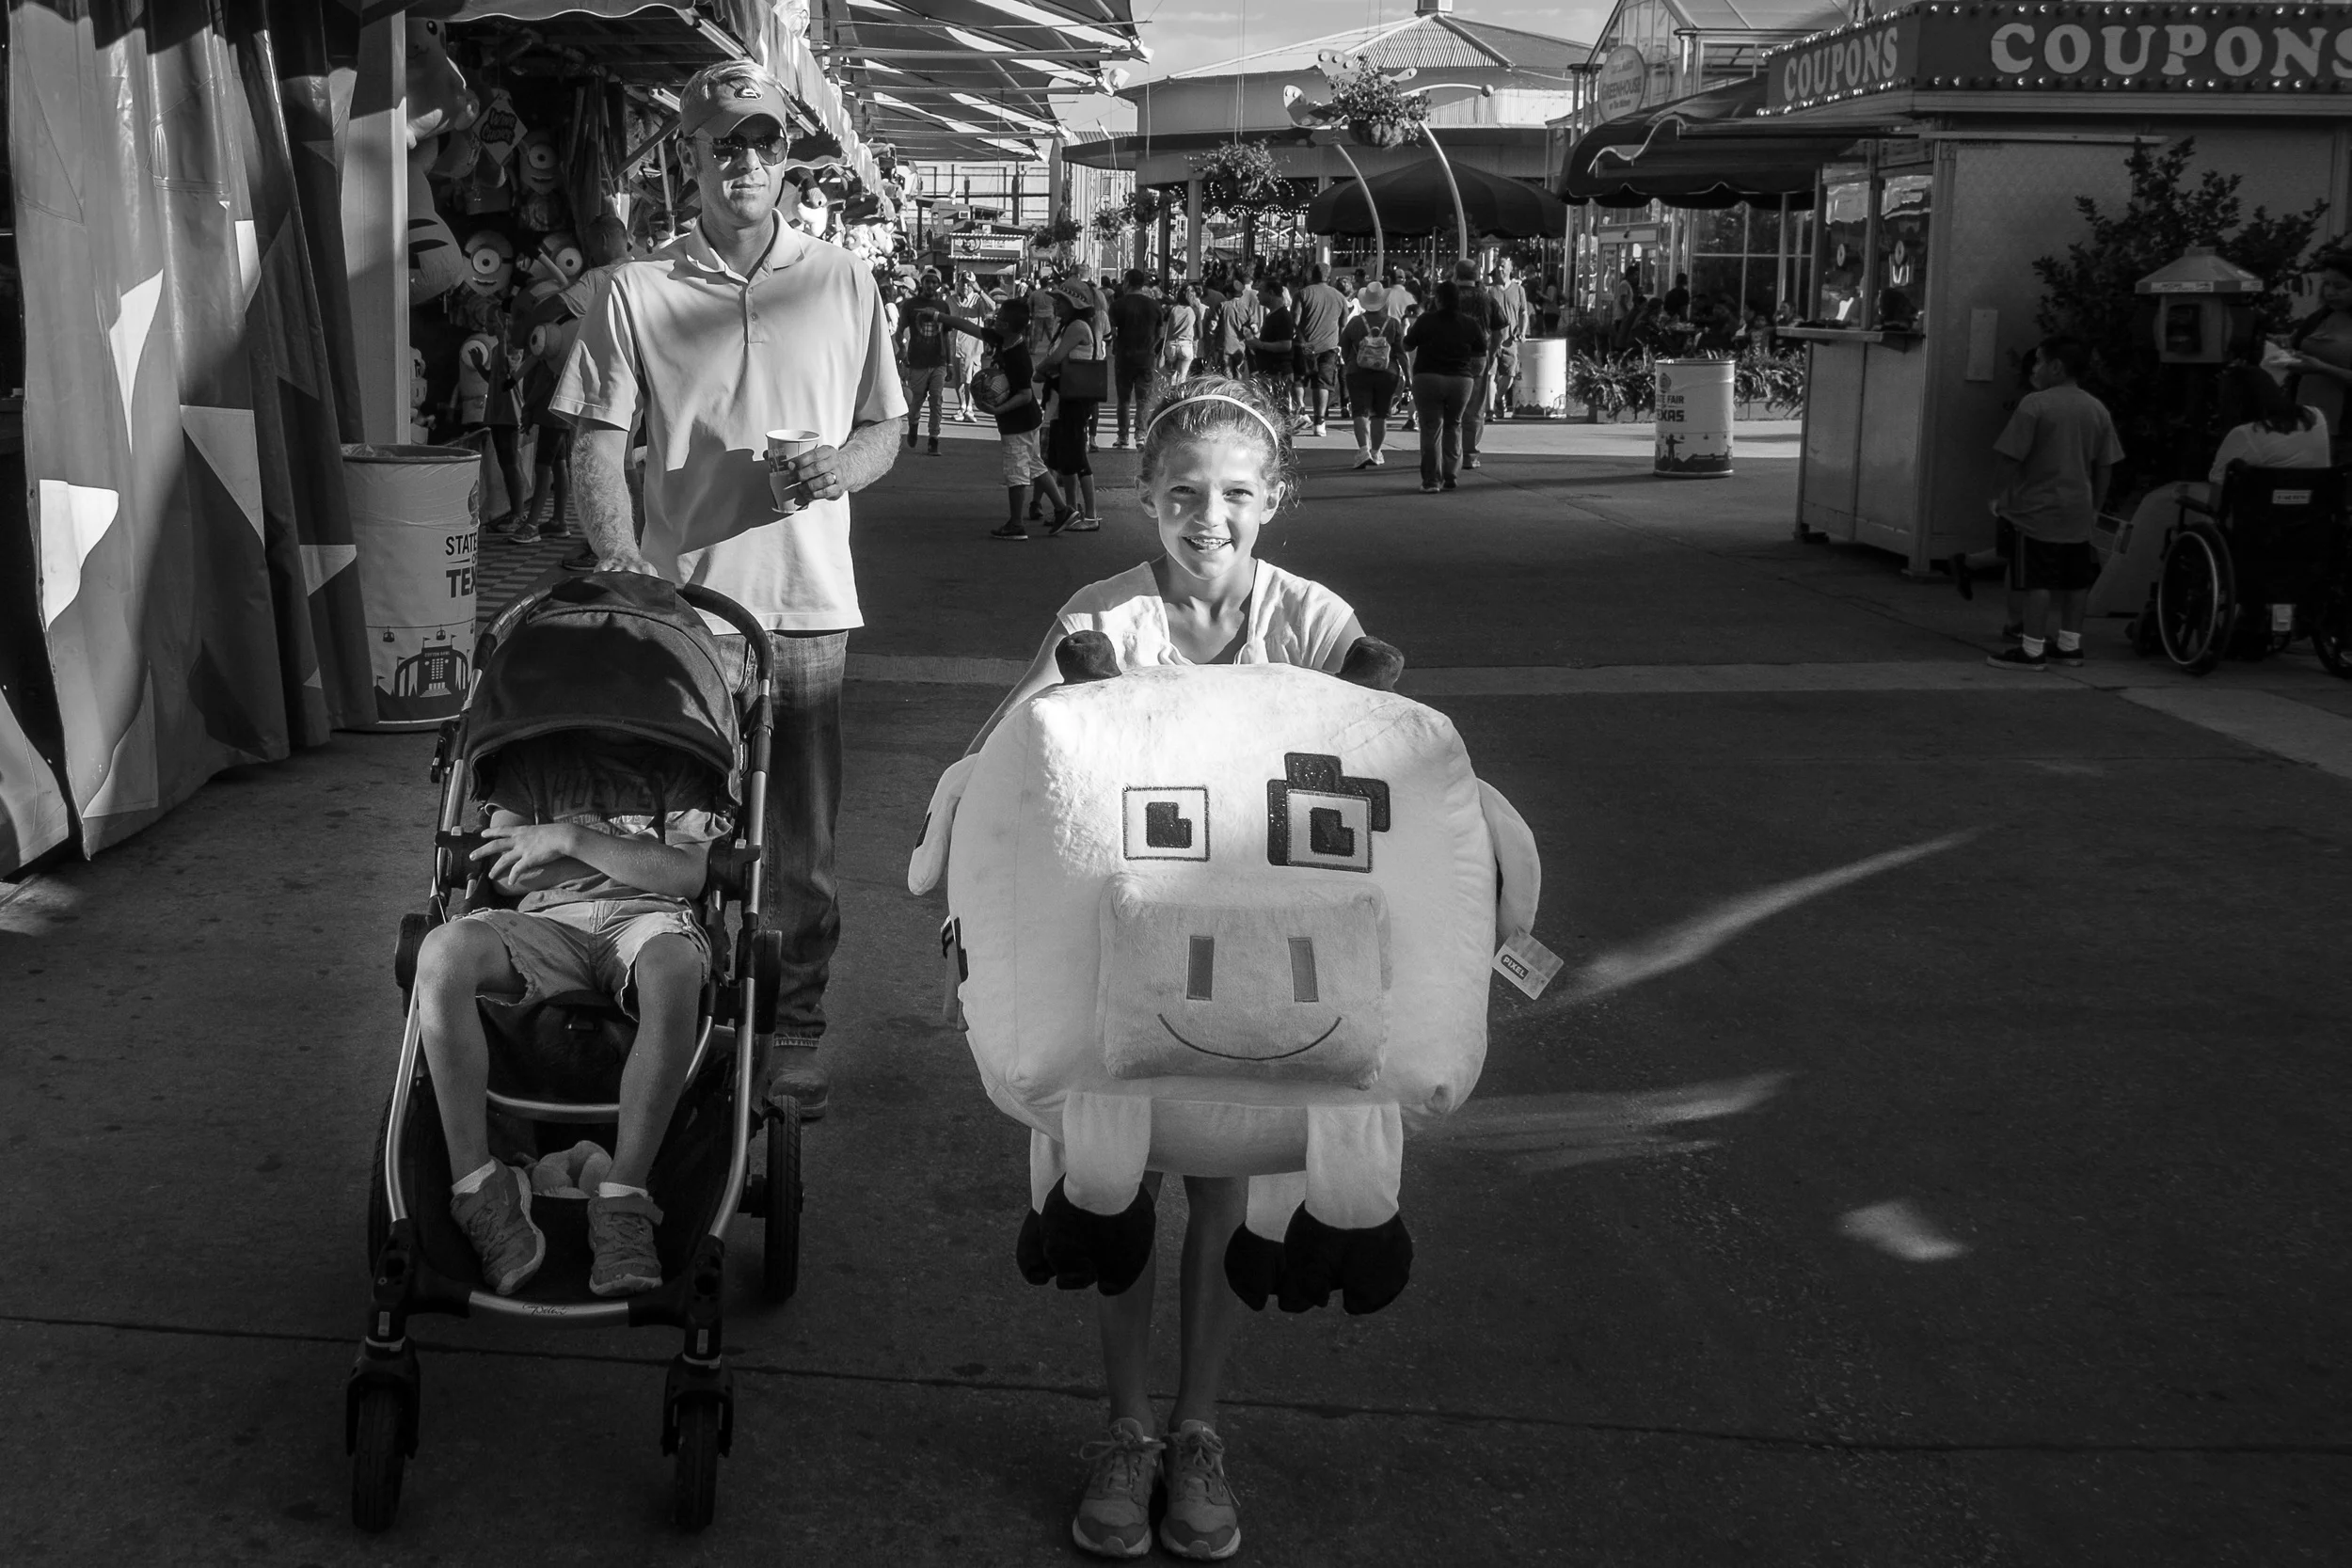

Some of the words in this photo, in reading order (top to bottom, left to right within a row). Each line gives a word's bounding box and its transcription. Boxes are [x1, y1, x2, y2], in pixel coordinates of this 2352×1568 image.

[1990, 22, 2352, 79] COUPONS
[1784, 26, 1899, 102] COUPONS
[1667, 394, 1685, 404] FAIR
[445, 531, 478, 557] STATE
[1502, 956, 1527, 977] PIXEL
